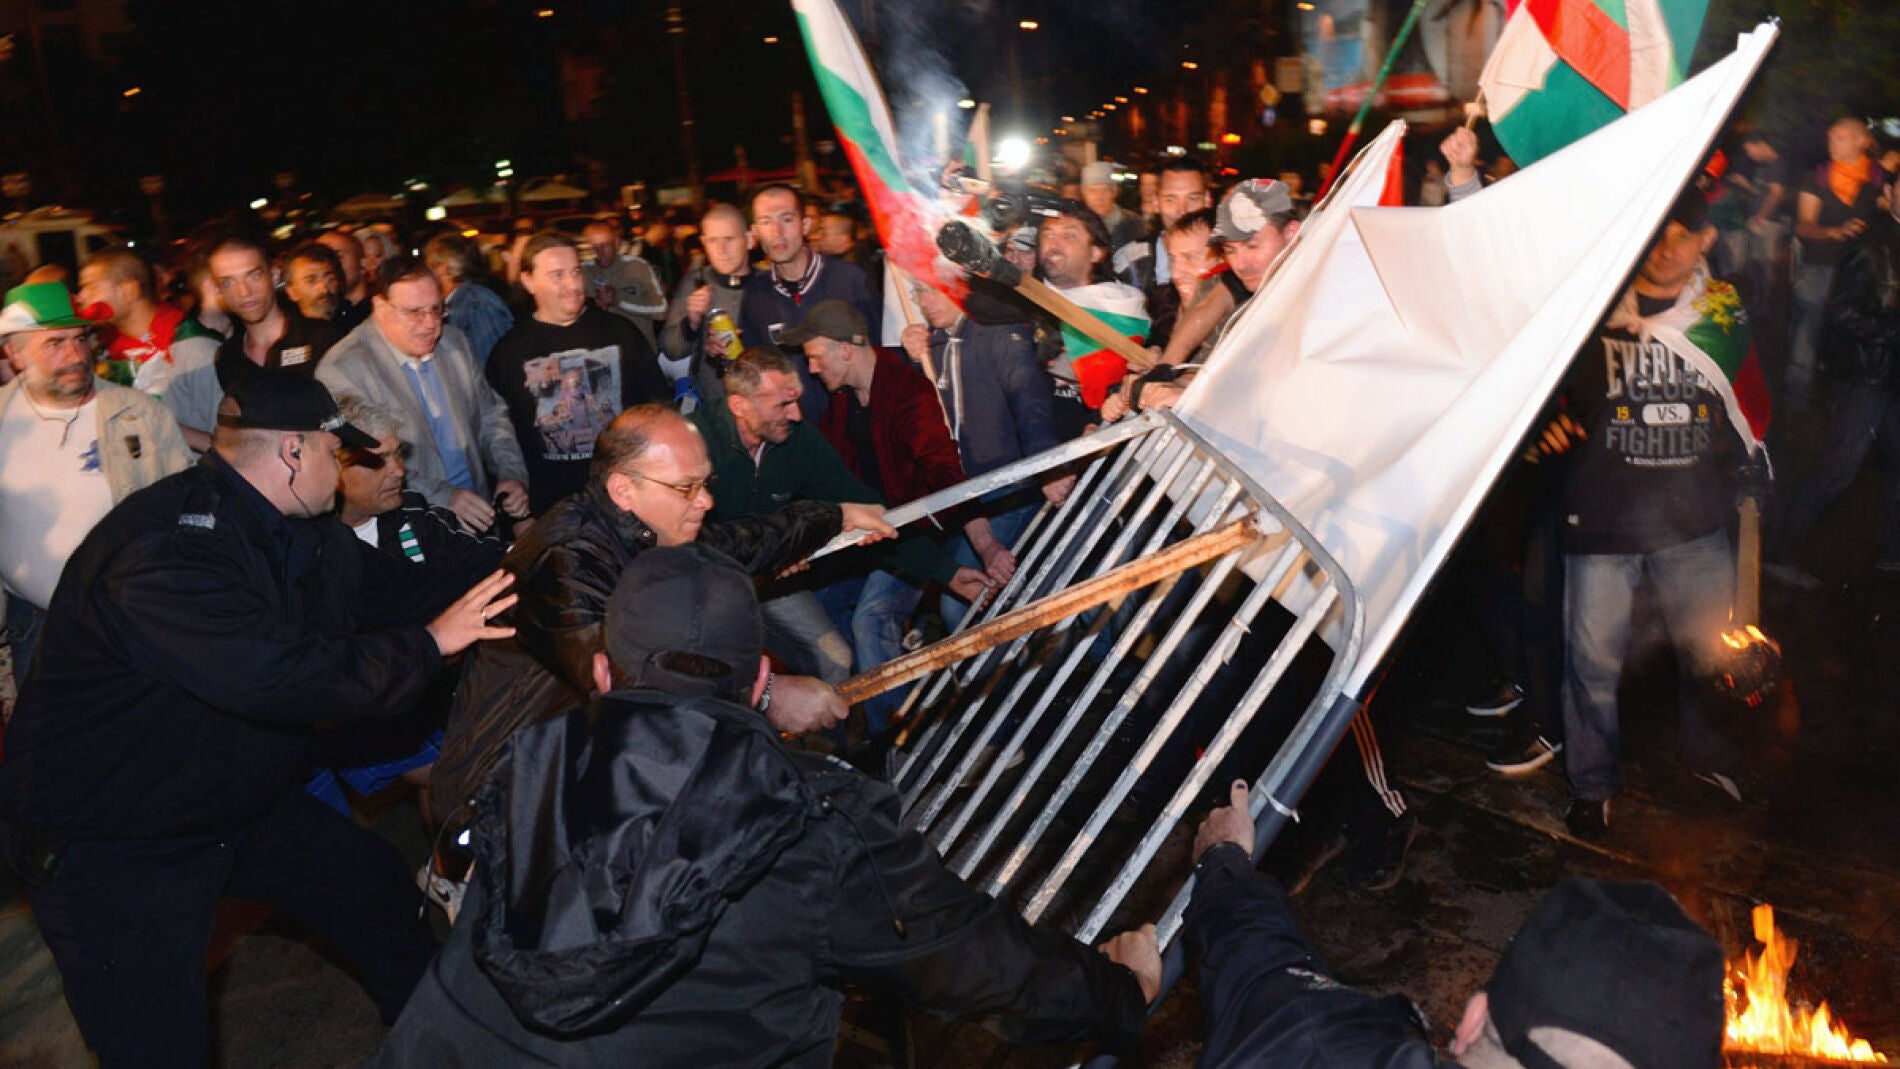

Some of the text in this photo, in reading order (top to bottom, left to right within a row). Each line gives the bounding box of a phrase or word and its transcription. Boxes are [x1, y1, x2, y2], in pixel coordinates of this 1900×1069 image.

[1628, 372, 1698, 402] CLUB
[1656, 406, 1683, 421] VS.
[1606, 425, 1710, 456] FIGHTERS
